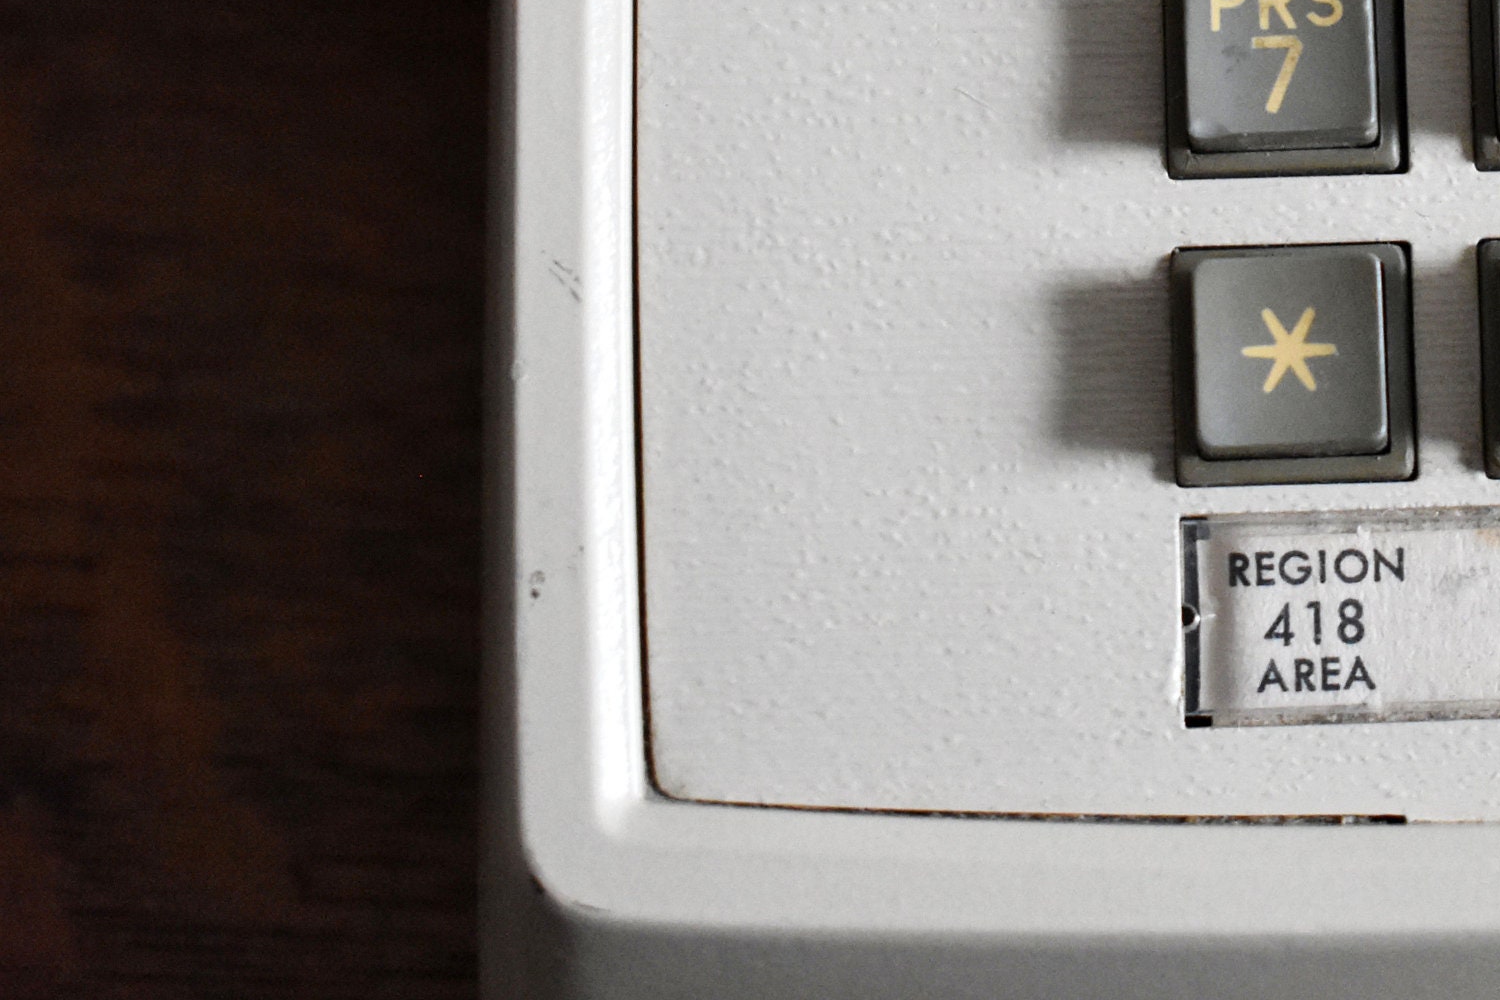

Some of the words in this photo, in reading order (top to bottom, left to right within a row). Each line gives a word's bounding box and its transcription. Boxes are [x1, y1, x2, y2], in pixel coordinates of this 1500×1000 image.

[1254, 36, 1302, 112] 7
[1228, 548, 1405, 587] REGION
[1264, 599, 1364, 646] 418
[1257, 656, 1375, 693] AREA
